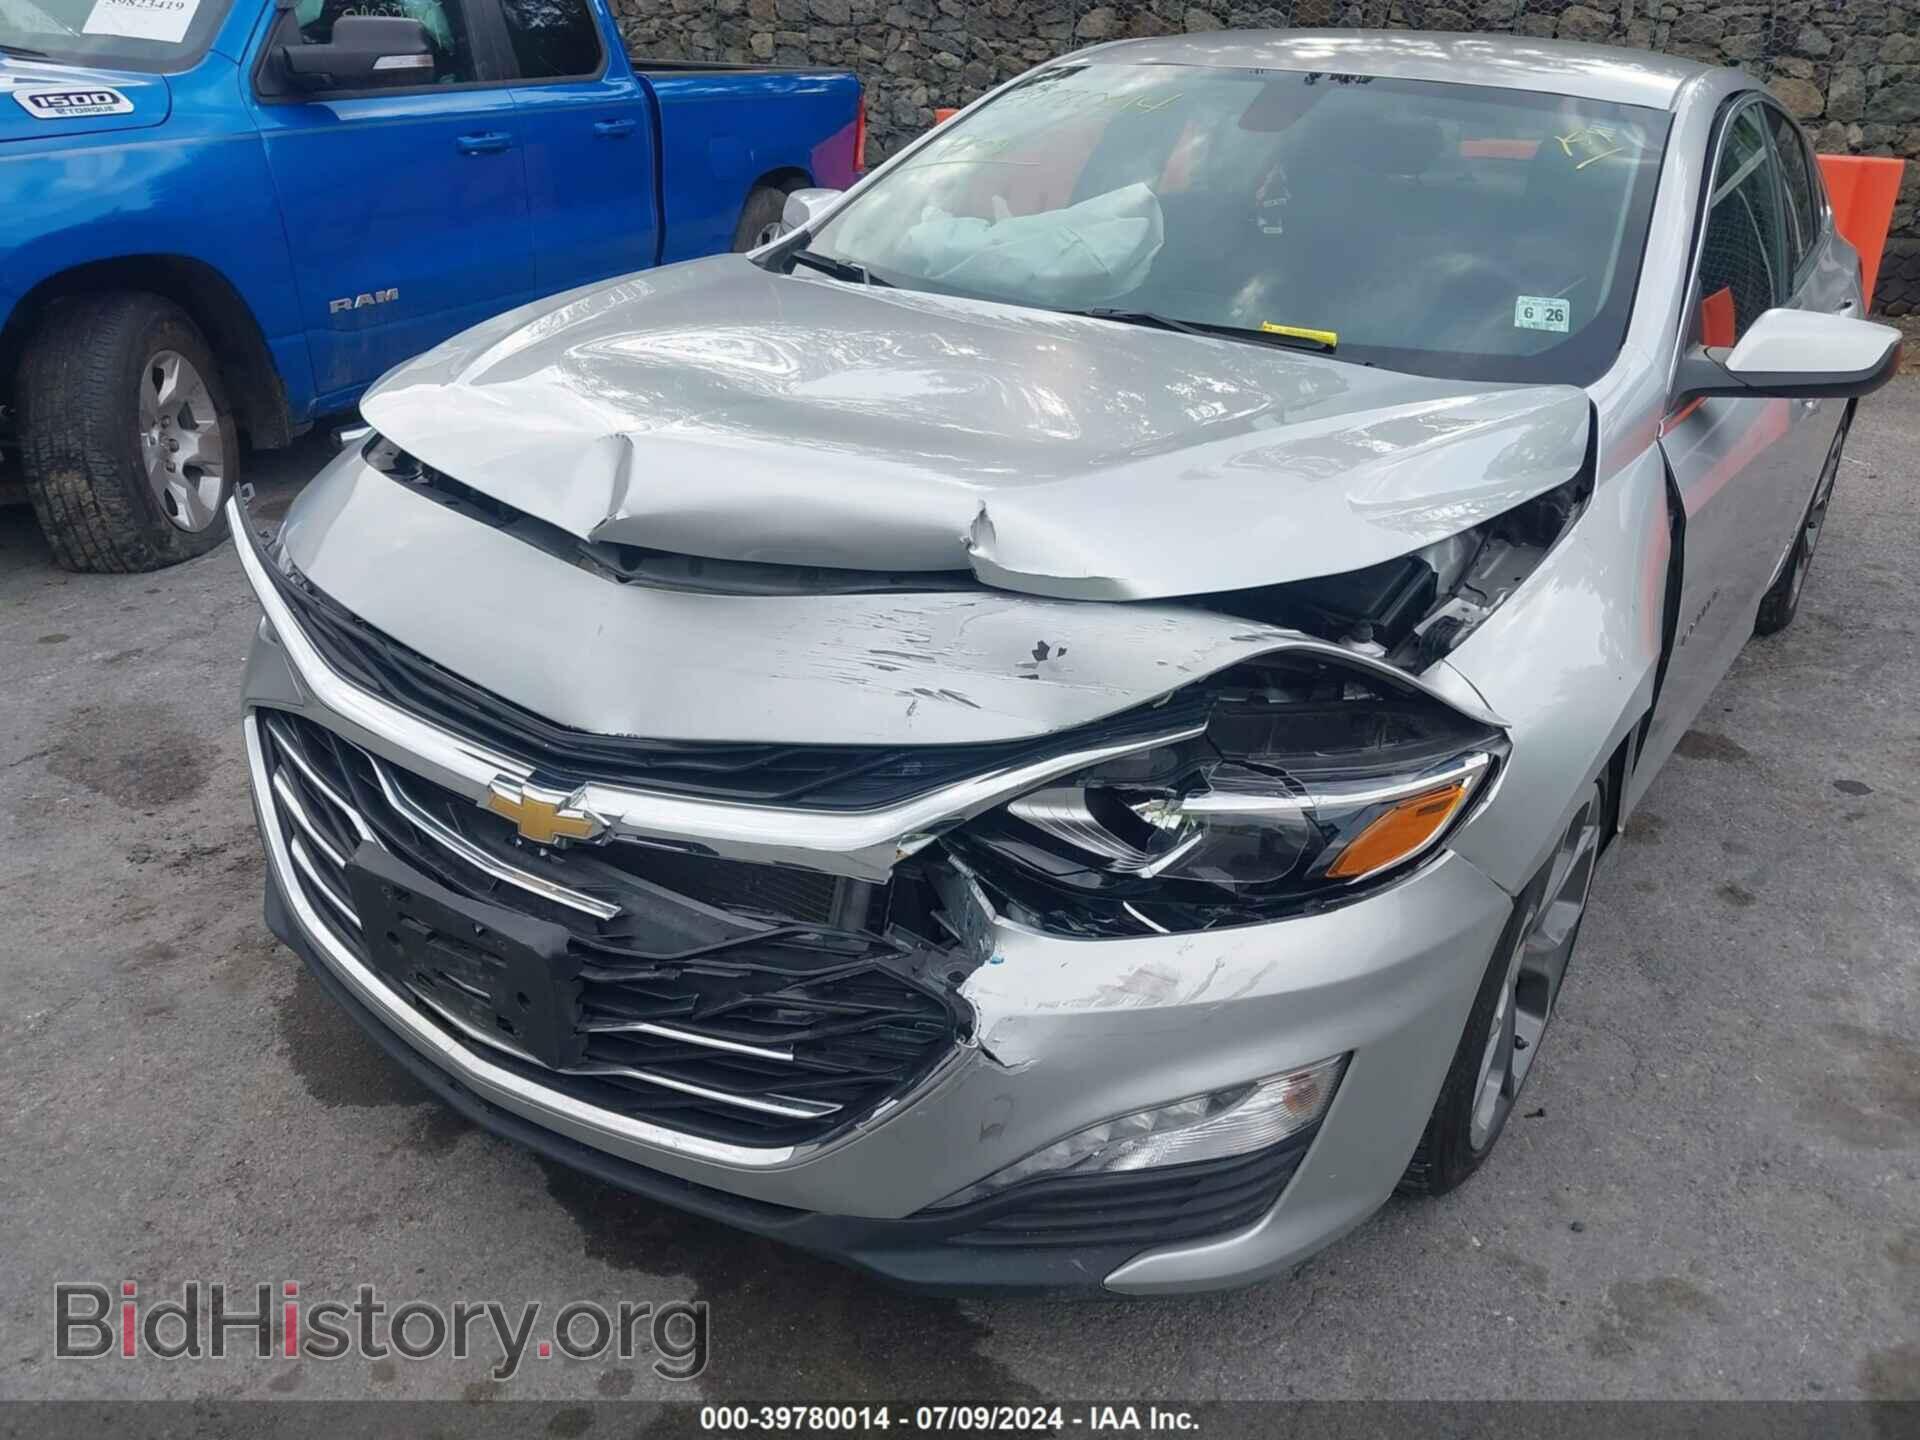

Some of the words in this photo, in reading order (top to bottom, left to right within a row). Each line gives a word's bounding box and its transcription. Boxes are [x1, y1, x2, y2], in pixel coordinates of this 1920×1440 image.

[34, 93, 113, 107] 1500
[329, 288, 399, 314] RAM
[1524, 307, 1534, 319] 6
[1546, 308, 1564, 322] 26
